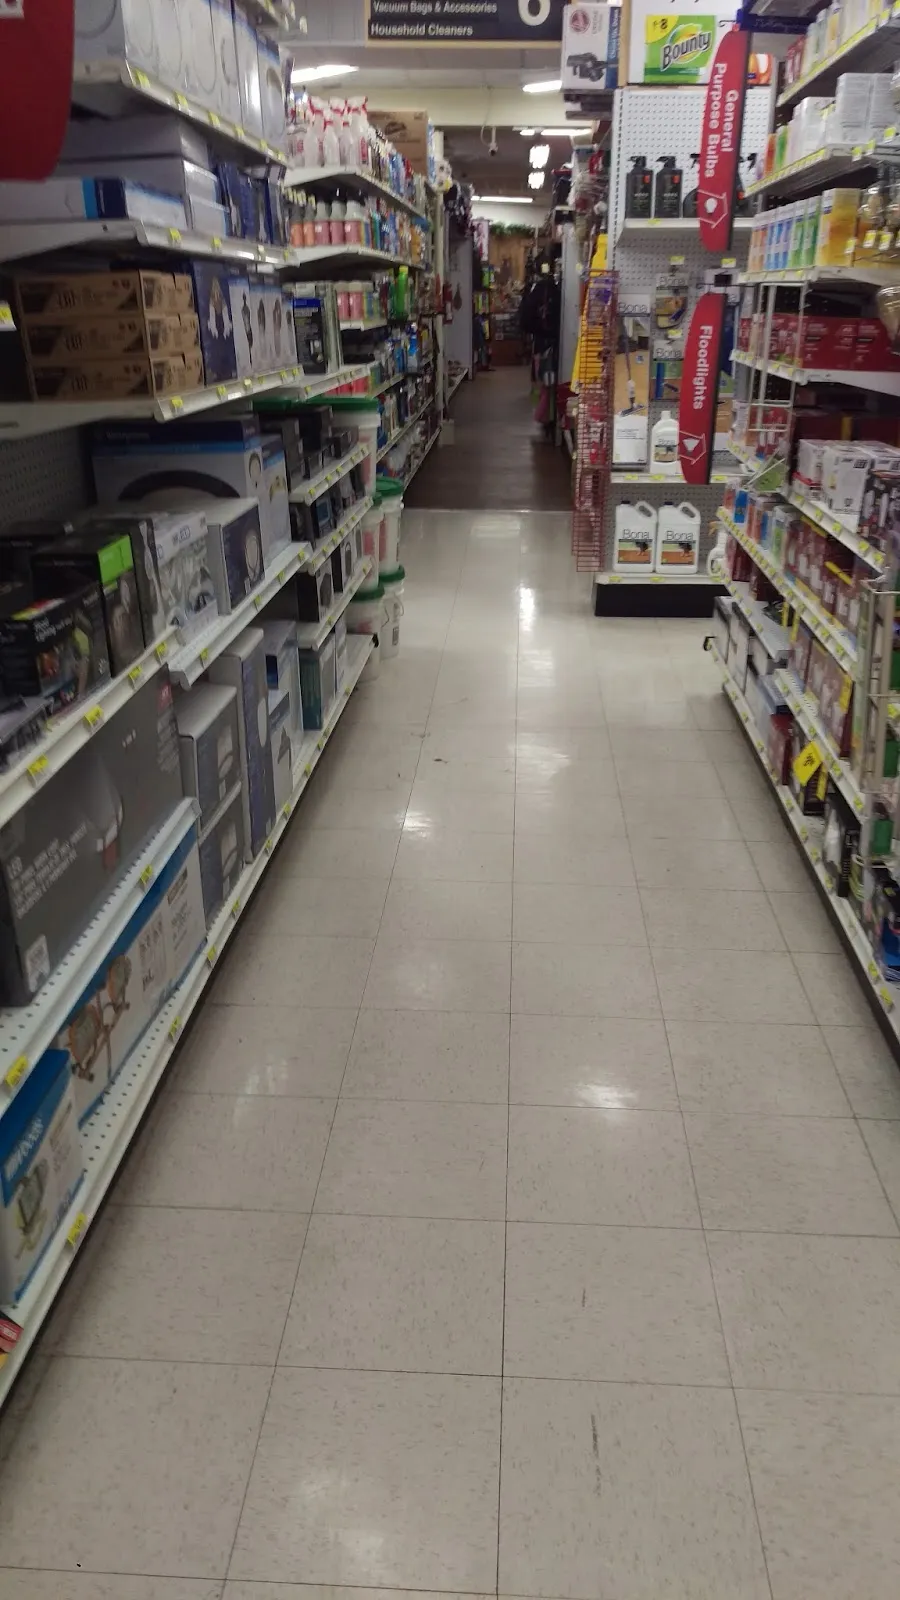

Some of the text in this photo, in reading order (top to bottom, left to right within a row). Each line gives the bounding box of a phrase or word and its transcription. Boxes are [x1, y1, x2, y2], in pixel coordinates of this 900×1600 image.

[373, 1, 498, 15] Vacuum Bags & Accessories
[371, 23, 473, 36] Household Cleaners
[660, 32, 712, 72] Bounty
[704, 63, 728, 178] Purpose Bulbs
[720, 90, 739, 152] General
[618, 302, 648, 313] Bona
[692, 325, 713, 410] Floodlights
[622, 529, 650, 540] Bona
[666, 530, 694, 541] Bona
